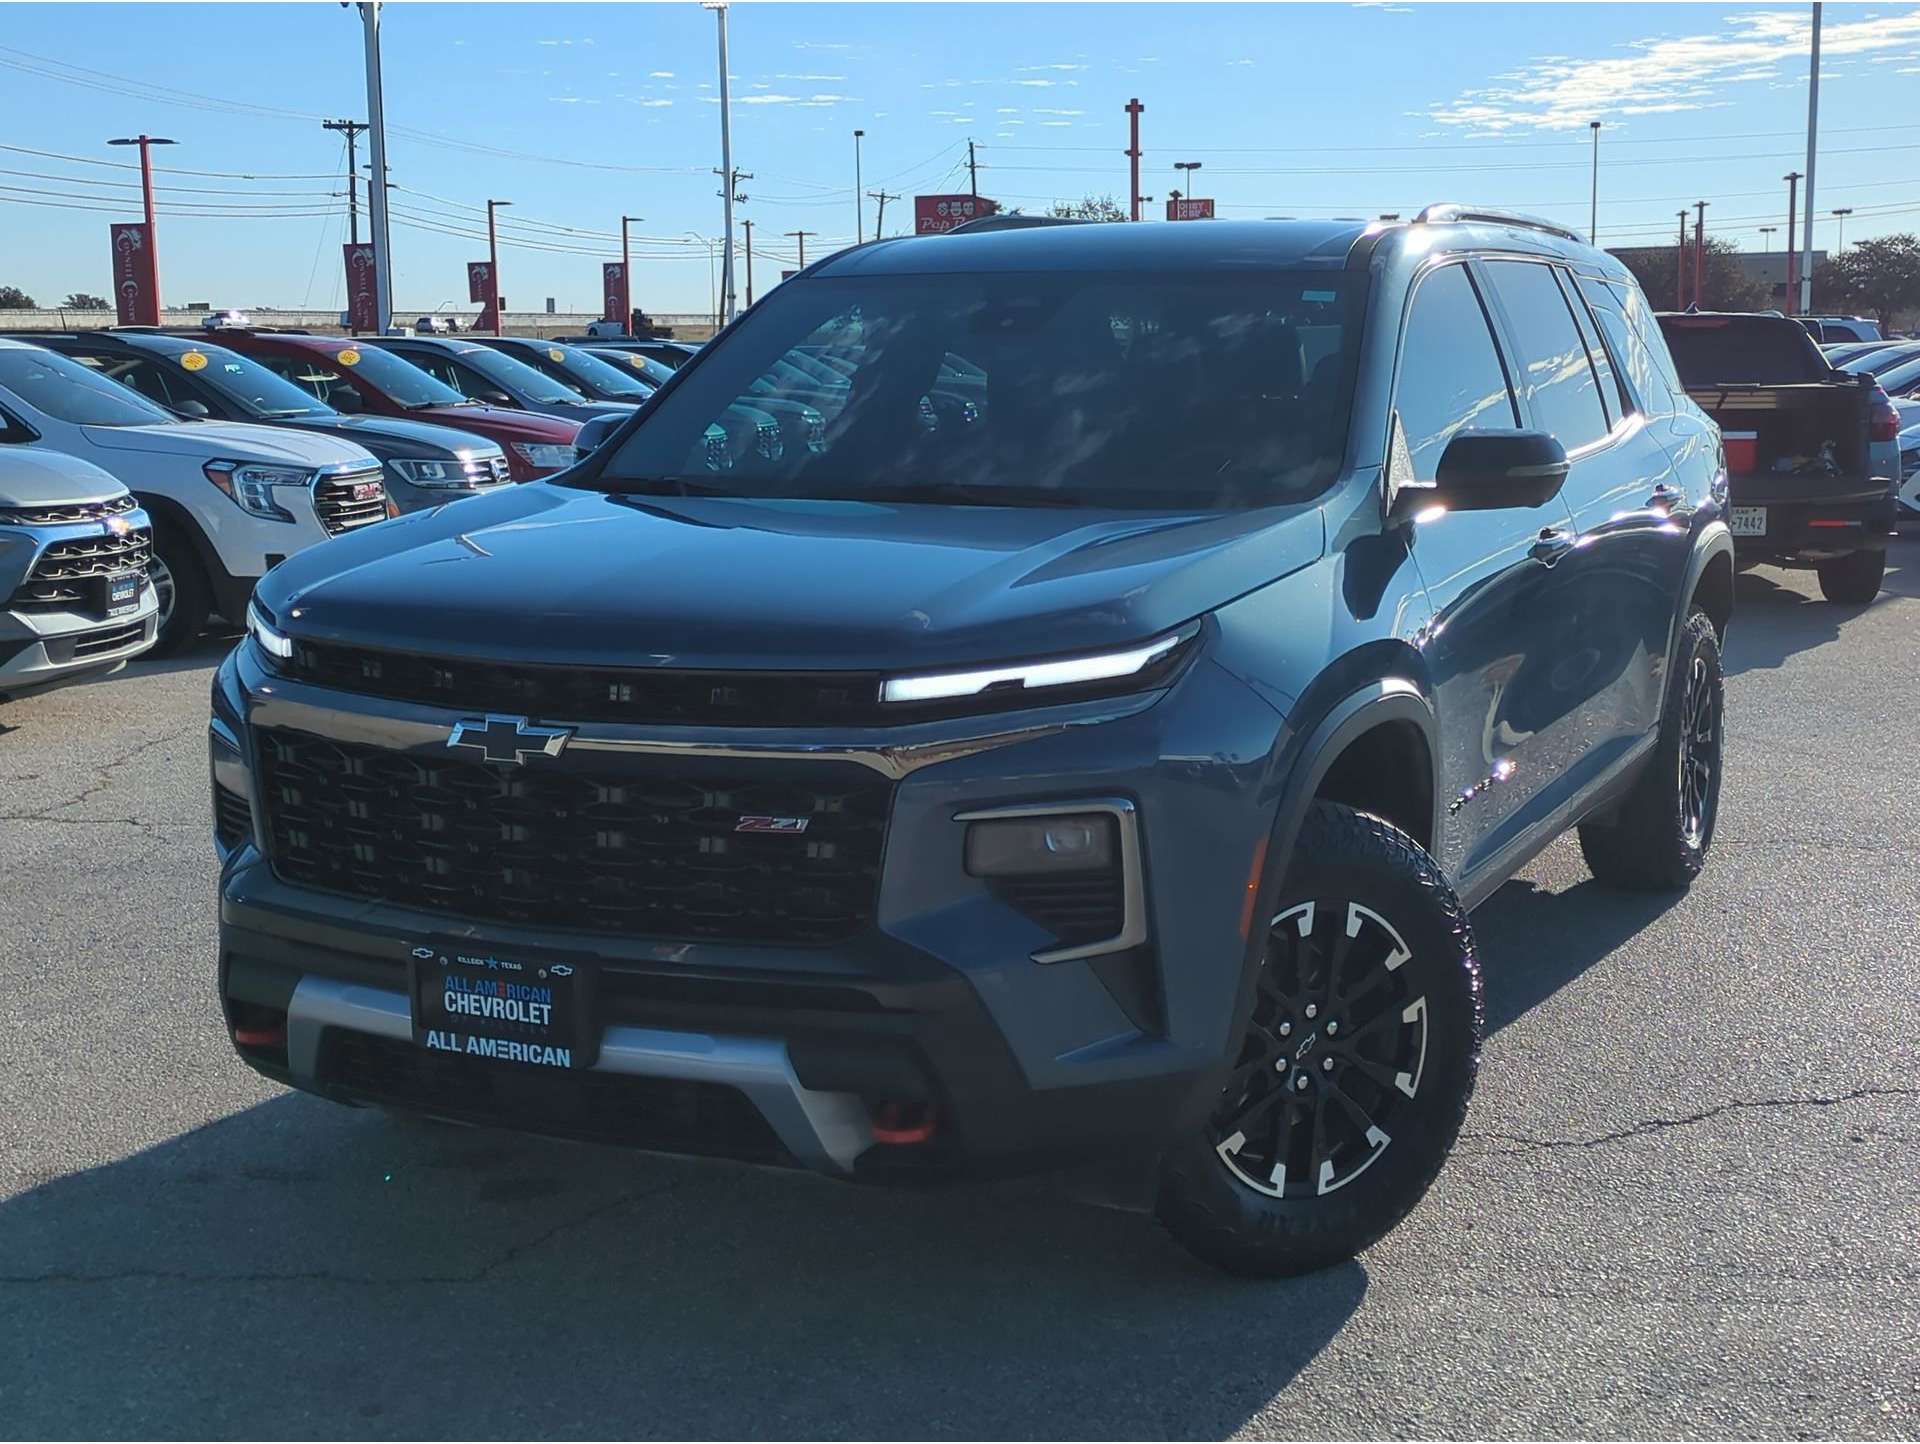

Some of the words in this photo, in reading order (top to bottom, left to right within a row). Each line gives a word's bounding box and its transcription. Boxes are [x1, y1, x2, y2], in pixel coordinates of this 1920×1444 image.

[501, 961, 522, 970] TEXAS
[444, 976, 471, 992] ALL
[475, 980, 551, 1003] AMERICAN
[444, 991, 552, 1025] CHEVROLET
[426, 1030, 463, 1052] ALL
[466, 1036, 571, 1068] AMERICAN
